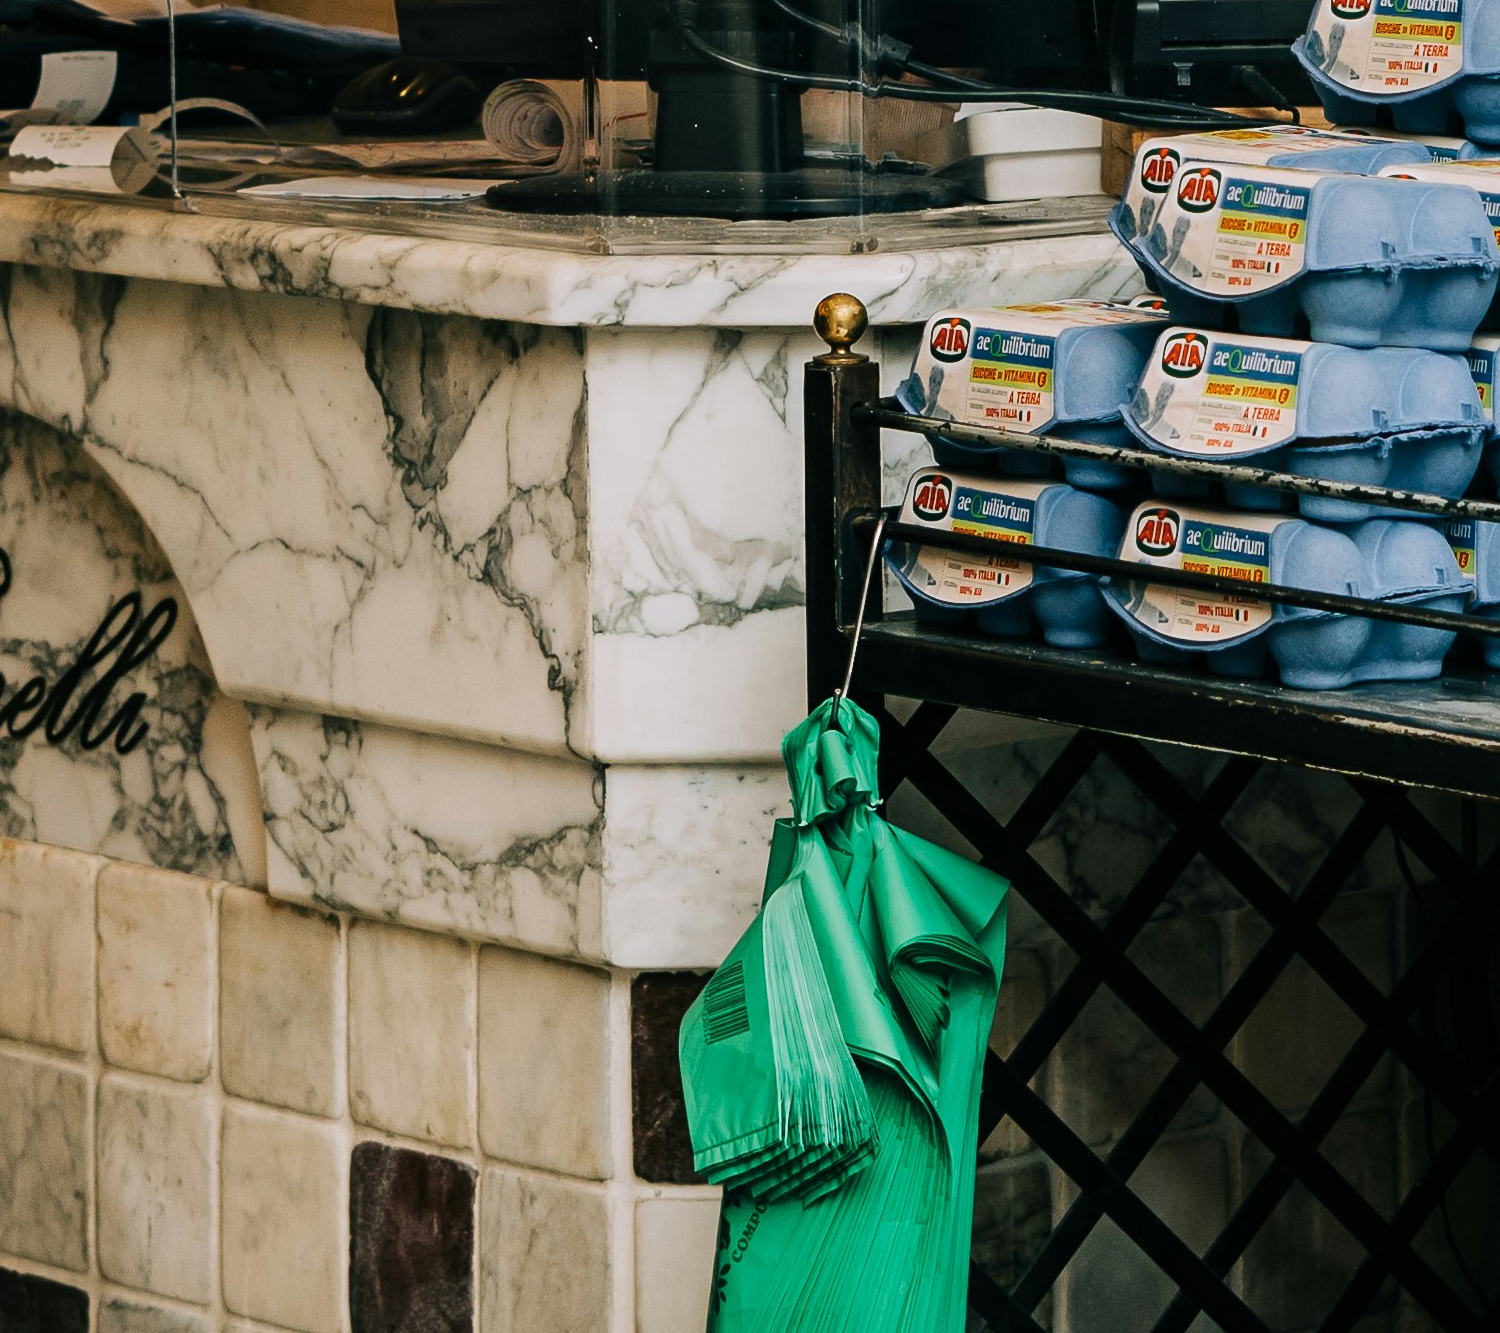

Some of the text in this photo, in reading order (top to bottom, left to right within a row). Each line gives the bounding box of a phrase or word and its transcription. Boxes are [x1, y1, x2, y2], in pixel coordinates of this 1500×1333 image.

[1422, 44, 1449, 57] TERRA
[1404, 60, 1423, 71] ITALIA
[1226, 183, 1305, 211] aeQuilibrium
[1265, 242, 1291, 257] TERRA
[976, 334, 1051, 359] aeQuilibrium
[1213, 349, 1296, 376] aeQuilibrium
[1016, 391, 1041, 406] TERRA
[1251, 407, 1281, 422] TERRA
[957, 494, 1030, 523] aeQuilibrium
[1186, 528, 1265, 556] aeQuilibrium
